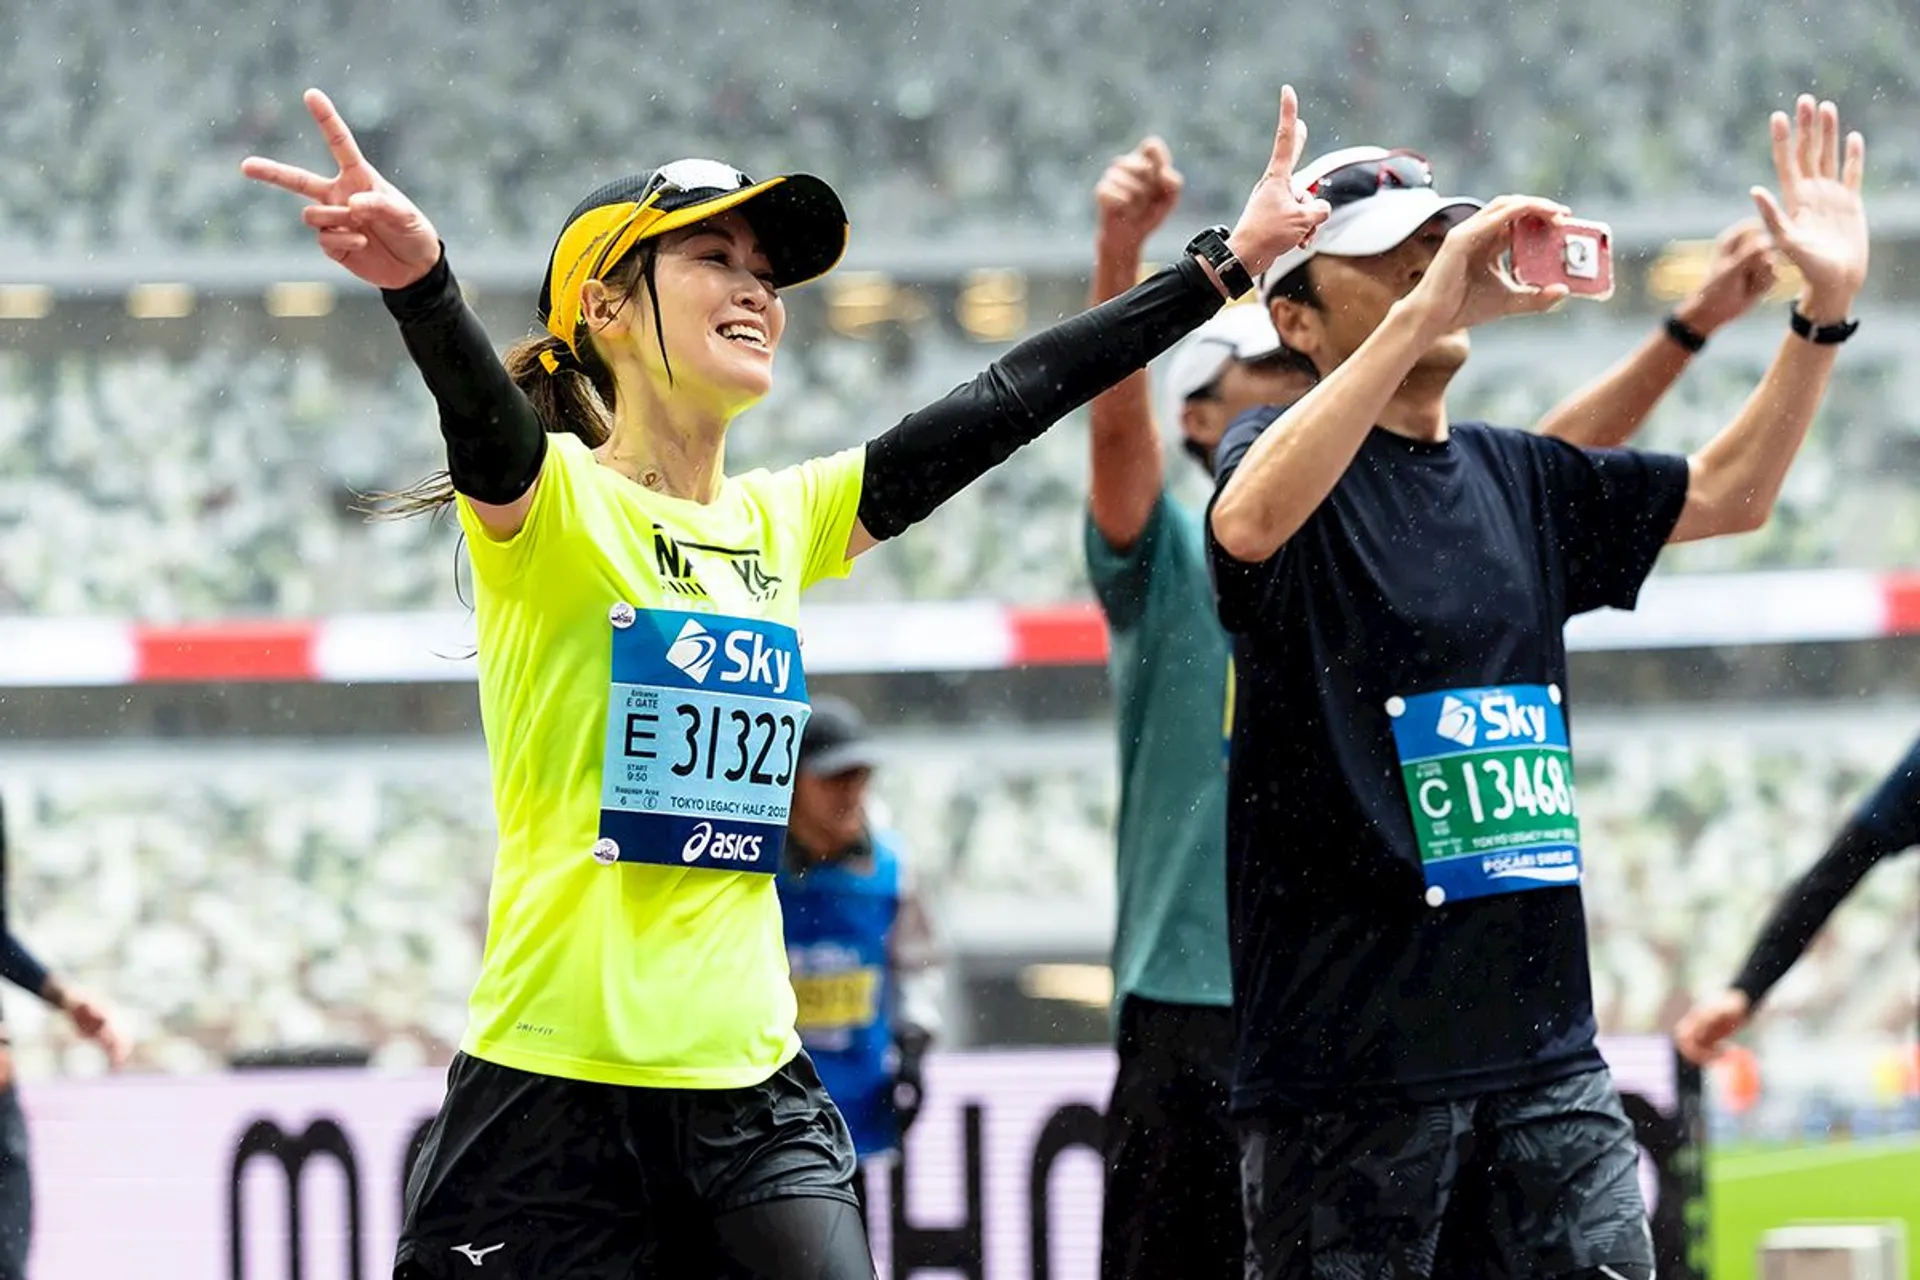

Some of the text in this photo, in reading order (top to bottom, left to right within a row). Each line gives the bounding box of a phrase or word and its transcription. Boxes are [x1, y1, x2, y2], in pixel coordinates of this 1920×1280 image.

[720, 629, 791, 694] Sky
[635, 699, 659, 709] GATE
[1480, 696, 1546, 743] Sky
[624, 713, 659, 759] E
[670, 703, 796, 787] 31323
[670, 796, 705, 811] TOKYO
[705, 800, 740, 814] LEGACY
[742, 803, 766, 816] HALF
[1419, 778, 1452, 819] C
